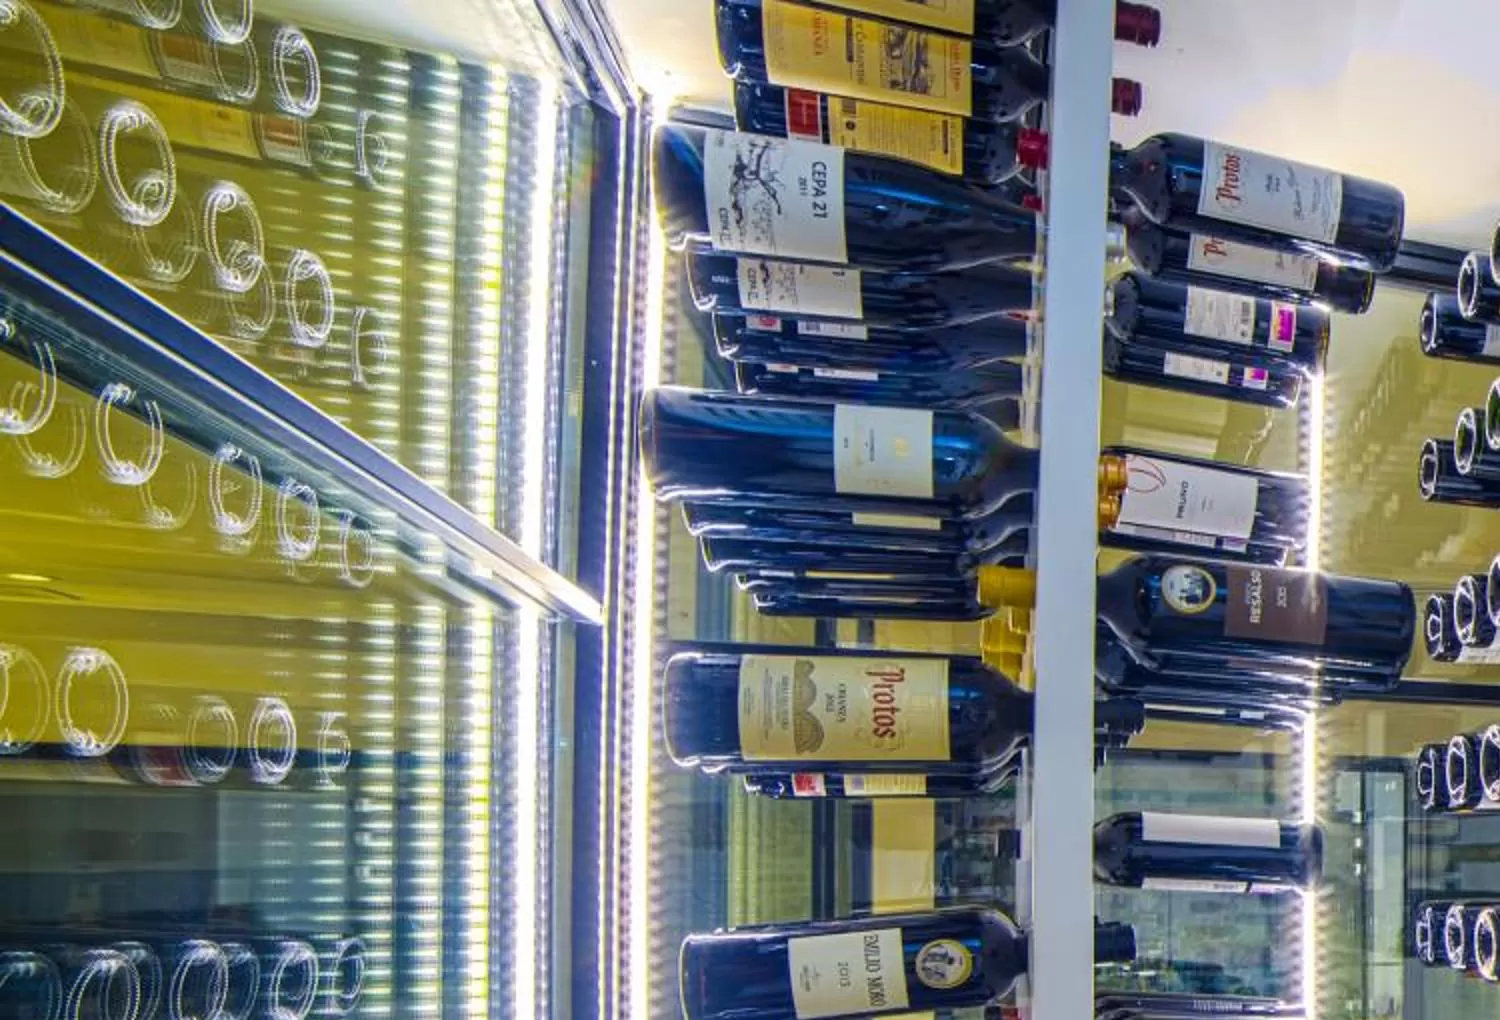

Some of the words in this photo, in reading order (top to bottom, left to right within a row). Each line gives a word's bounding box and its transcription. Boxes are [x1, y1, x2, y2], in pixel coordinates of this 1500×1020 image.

[811, 162, 828, 198] CEPA
[1215, 153, 1242, 202] Protos
[813, 201, 829, 219] 21
[1248, 570, 1262, 623] RESALSO
[864, 668, 905, 739] Protos
[863, 934, 881, 973] EMILIO
[866, 976, 887, 1008] MORO
